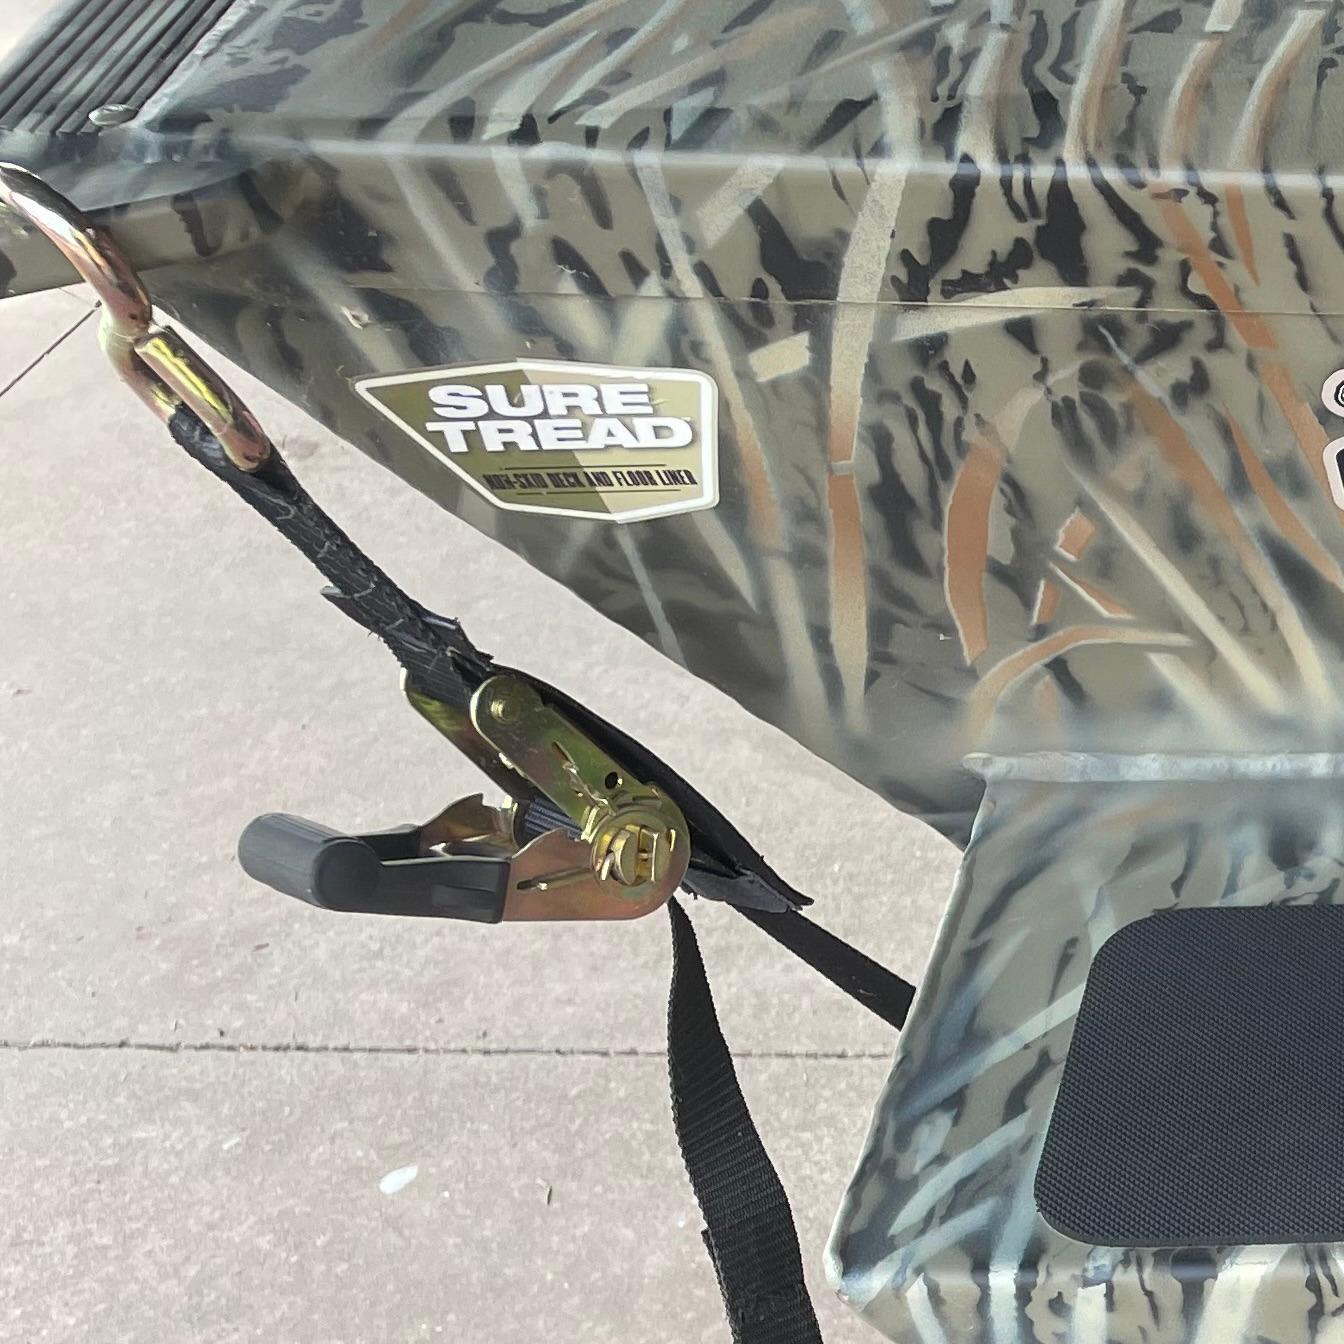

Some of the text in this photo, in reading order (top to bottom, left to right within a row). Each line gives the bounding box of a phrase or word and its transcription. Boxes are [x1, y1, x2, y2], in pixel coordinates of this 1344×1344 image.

[427, 383, 654, 419] SURE
[425, 416, 694, 453] TREAD
[546, 471, 586, 489] DECK
[583, 470, 614, 488] AND
[612, 469, 659, 487] FLOOR
[655, 468, 698, 486] LINER
